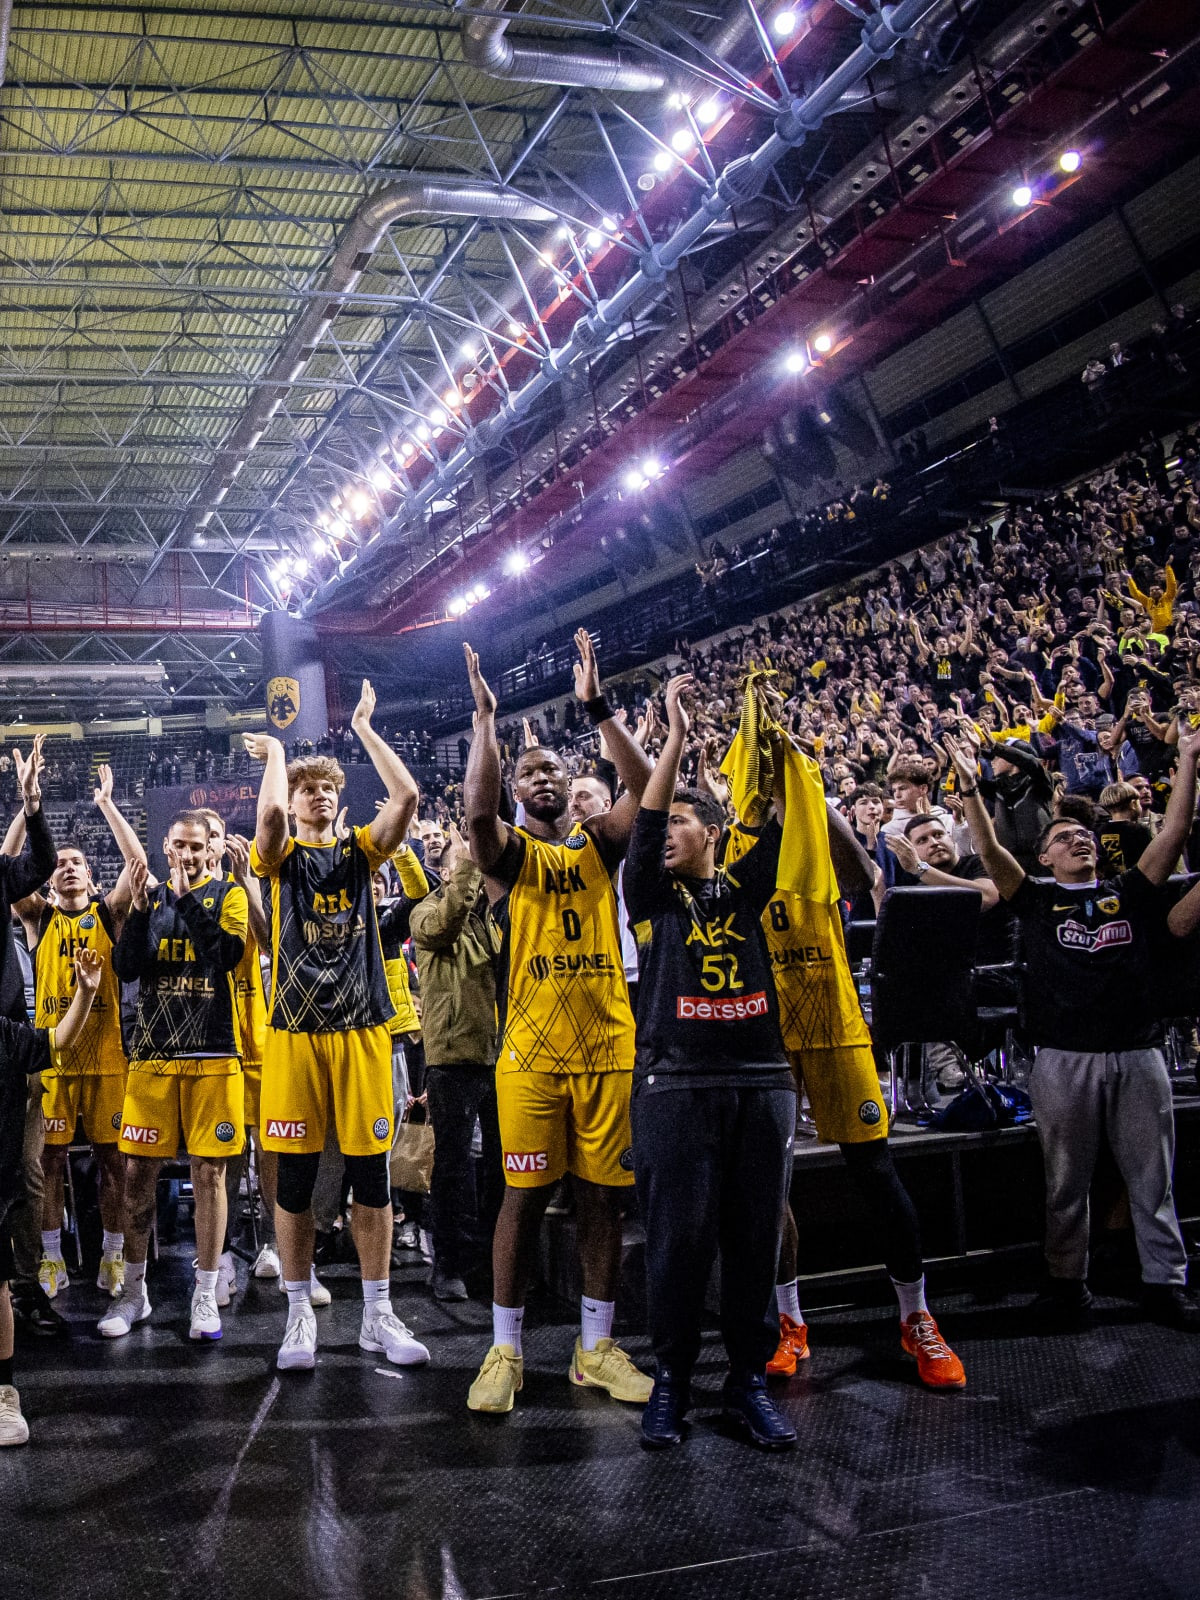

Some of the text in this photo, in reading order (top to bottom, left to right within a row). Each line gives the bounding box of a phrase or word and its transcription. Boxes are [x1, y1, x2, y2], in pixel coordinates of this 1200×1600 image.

[545, 864, 587, 895] AEK
[312, 888, 353, 914] AEK
[562, 908, 581, 941] 0
[769, 900, 790, 932] 8
[686, 912, 746, 948] AEK
[553, 953, 615, 971] SUNEL
[770, 947, 832, 965] UNEL
[700, 953, 745, 992] 52
[158, 976, 215, 992] SUNEL
[680, 996, 768, 1018] betsson
[123, 1125, 159, 1143] AVIS
[267, 1121, 306, 1138] AVIS
[506, 1153, 548, 1171] AVIS
